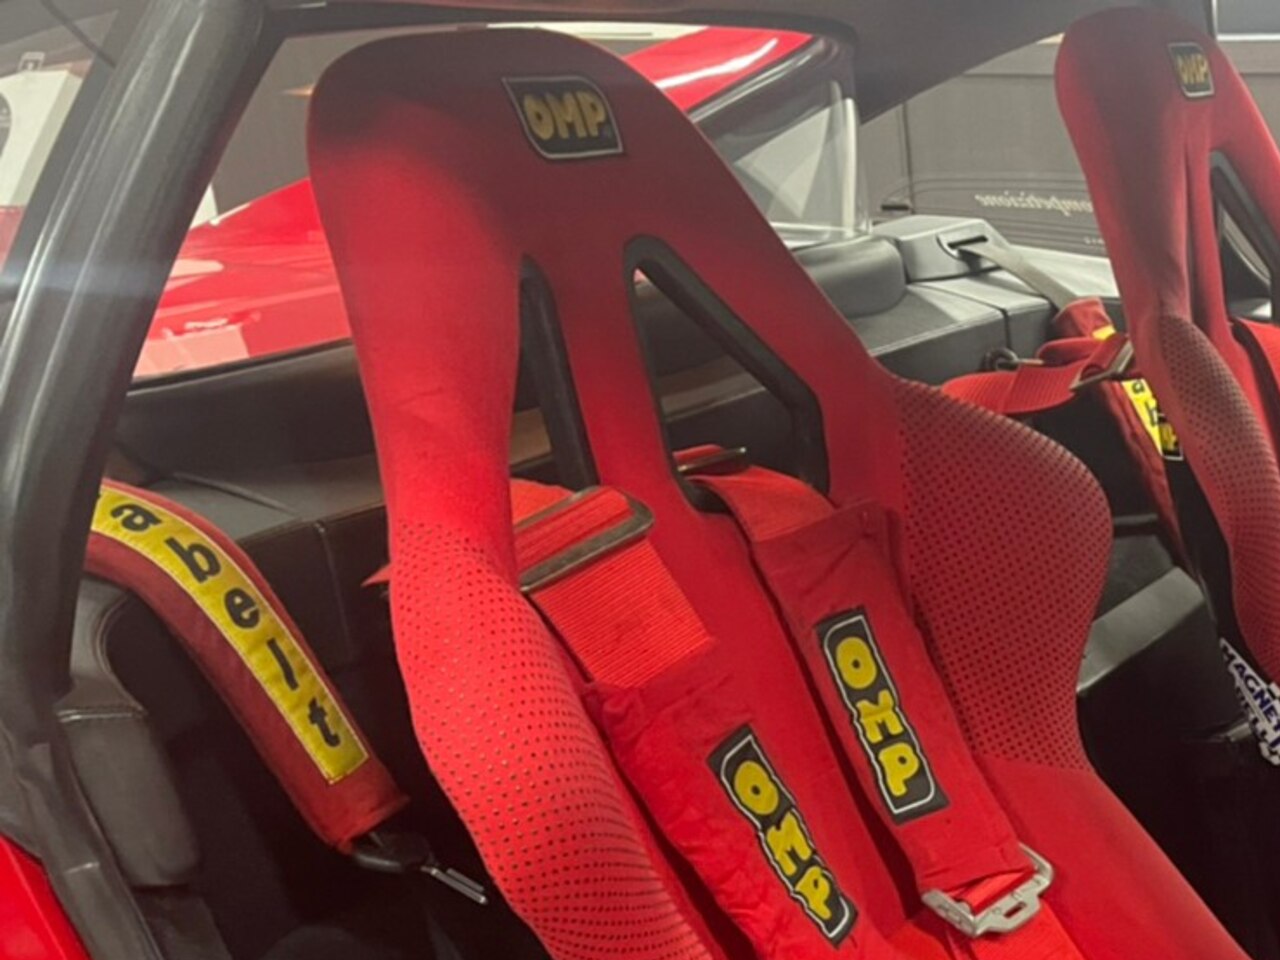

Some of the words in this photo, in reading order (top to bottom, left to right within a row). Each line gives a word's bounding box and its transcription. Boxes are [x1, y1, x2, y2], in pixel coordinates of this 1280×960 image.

[523, 91, 606, 140] OMP
[108, 502, 341, 748] abelt
[835, 636, 920, 797] OMP
[734, 760, 831, 920] OMP
